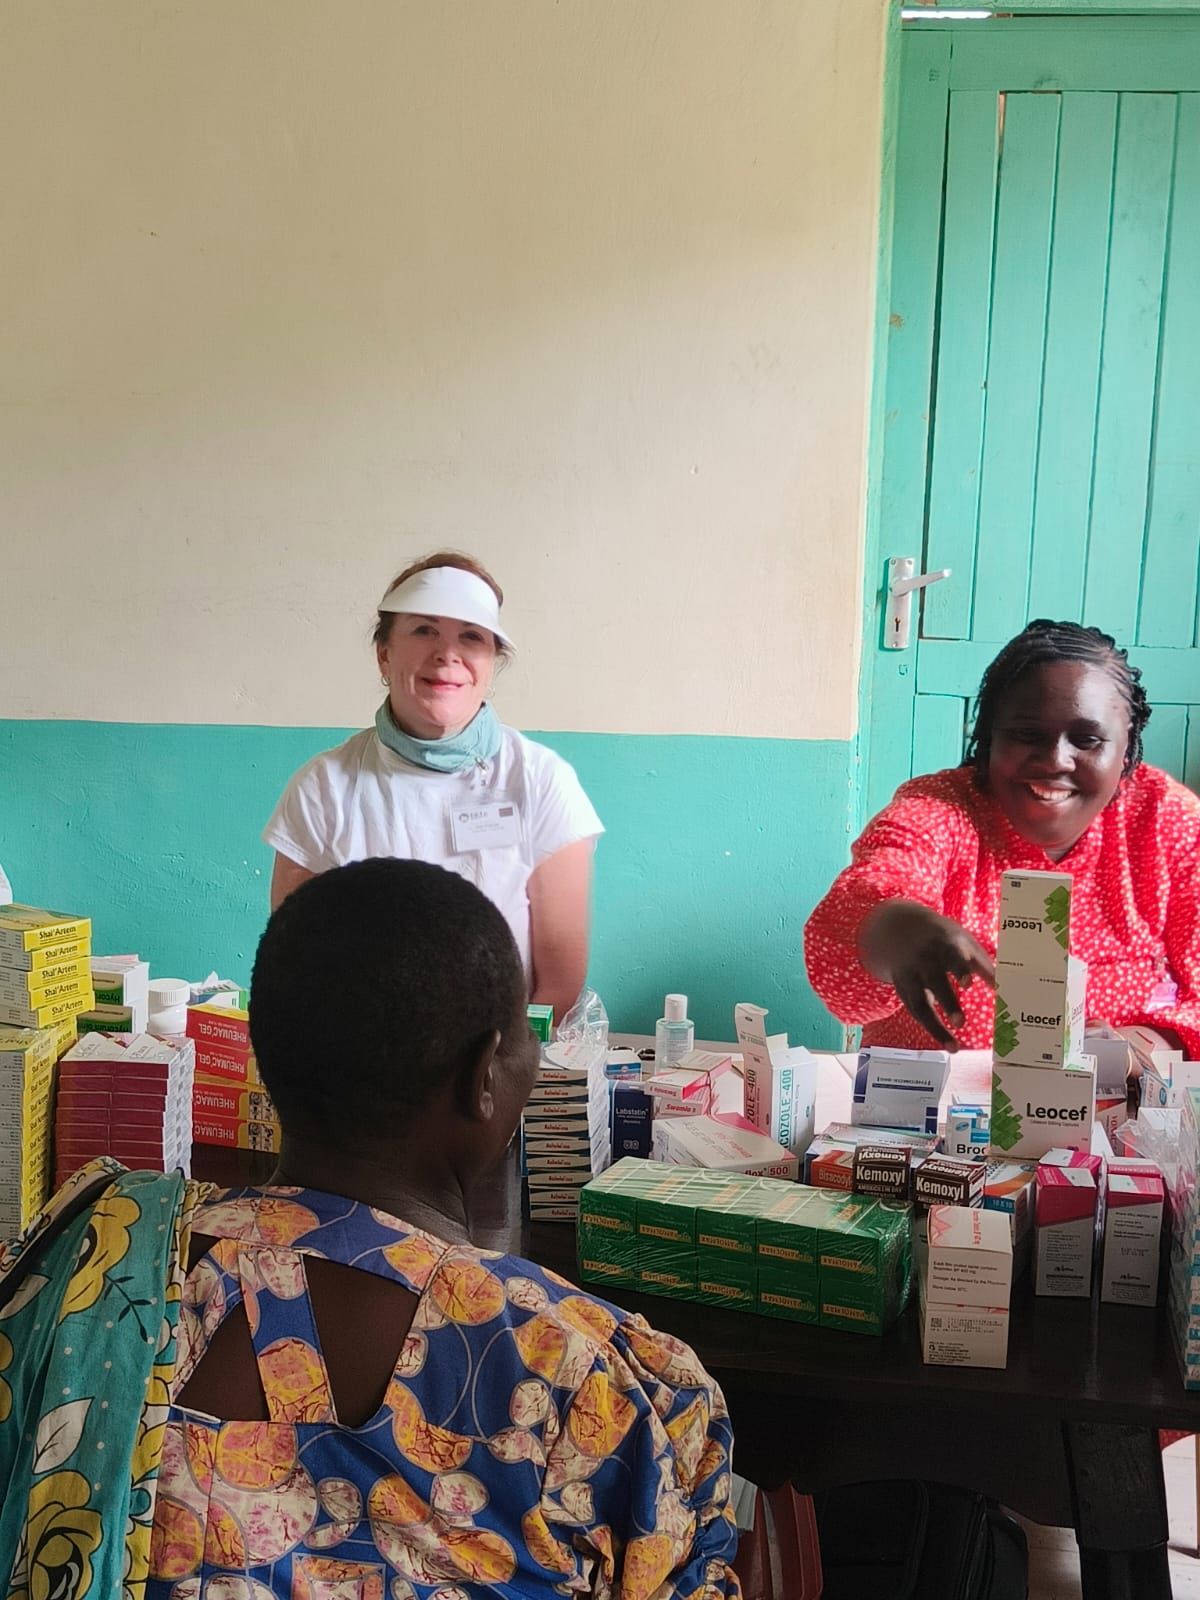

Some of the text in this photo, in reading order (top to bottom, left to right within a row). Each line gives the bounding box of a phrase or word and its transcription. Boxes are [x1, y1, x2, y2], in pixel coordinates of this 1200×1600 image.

[1002, 919, 1042, 932] Leocef
[1021, 1012, 1062, 1026] Leocef
[198, 1023, 212, 1036] GEL
[213, 1026, 247, 1042] RHEUMAC
[198, 1054, 211, 1064] GEL
[212, 1057, 245, 1074] RHEUMAC
[196, 1094, 236, 1109] RHEUMAC
[746, 1069, 757, 1124] ZOLE-400
[616, 1108, 646, 1116] Labstatin
[780, 1068, 792, 1148] COZOLE-400
[1026, 1102, 1088, 1121] Leocef
[194, 1125, 235, 1140] RHEUMAC
[858, 1152, 906, 1162] Kemoxyl
[770, 1167, 788, 1176] 500
[856, 1166, 906, 1186] Kemoxyl
[920, 1163, 970, 1177] Kemoxyl
[818, 1168, 850, 1188] Bisacodyl
[916, 1176, 964, 1200] Kemoxyl
